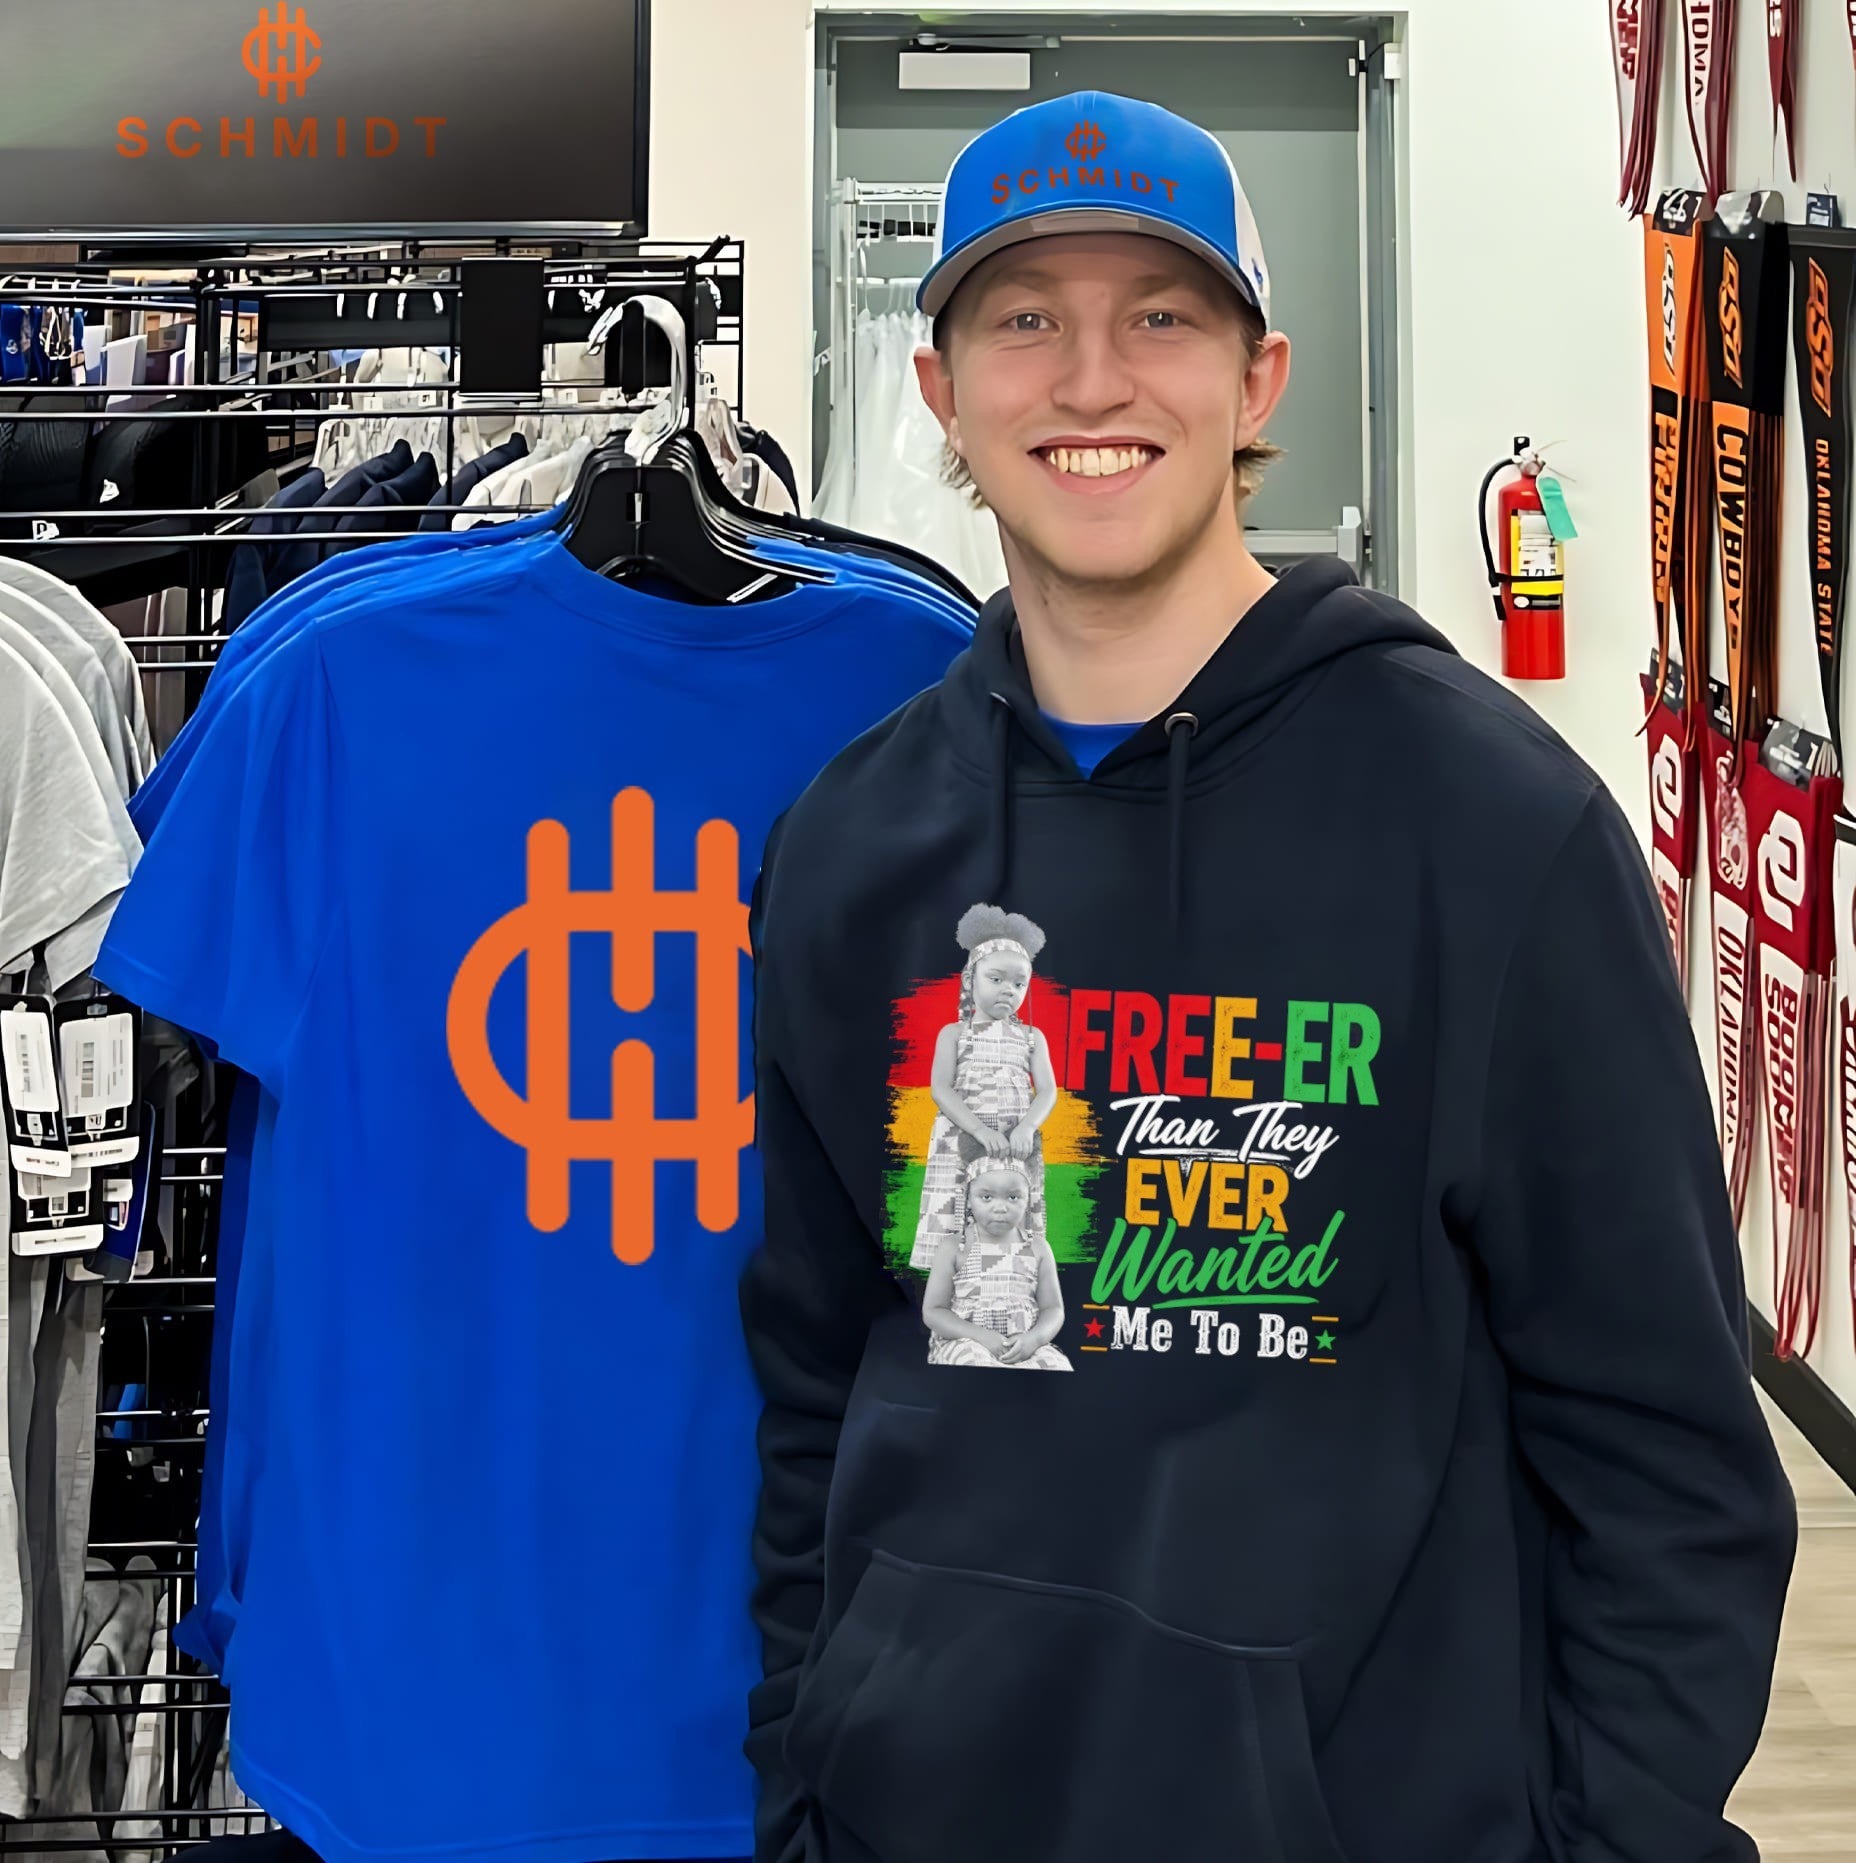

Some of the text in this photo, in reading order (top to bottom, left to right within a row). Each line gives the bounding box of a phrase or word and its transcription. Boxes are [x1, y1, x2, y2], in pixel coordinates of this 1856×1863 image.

[116, 116, 448, 158] SCHMIDT
[991, 167, 1180, 205] SCHMIDT
[1816, 438, 1834, 657] OKLAHOMA STATE
[1065, 988, 1382, 1106] FREE-ER
[1717, 926, 1745, 1144] OKLAHOMA
[1109, 1094, 1340, 1180] Than They
[1124, 1158, 1290, 1233] EVER
[1090, 1209, 1346, 1303] Wanted
[1110, 1306, 1309, 1360] Me To Be
